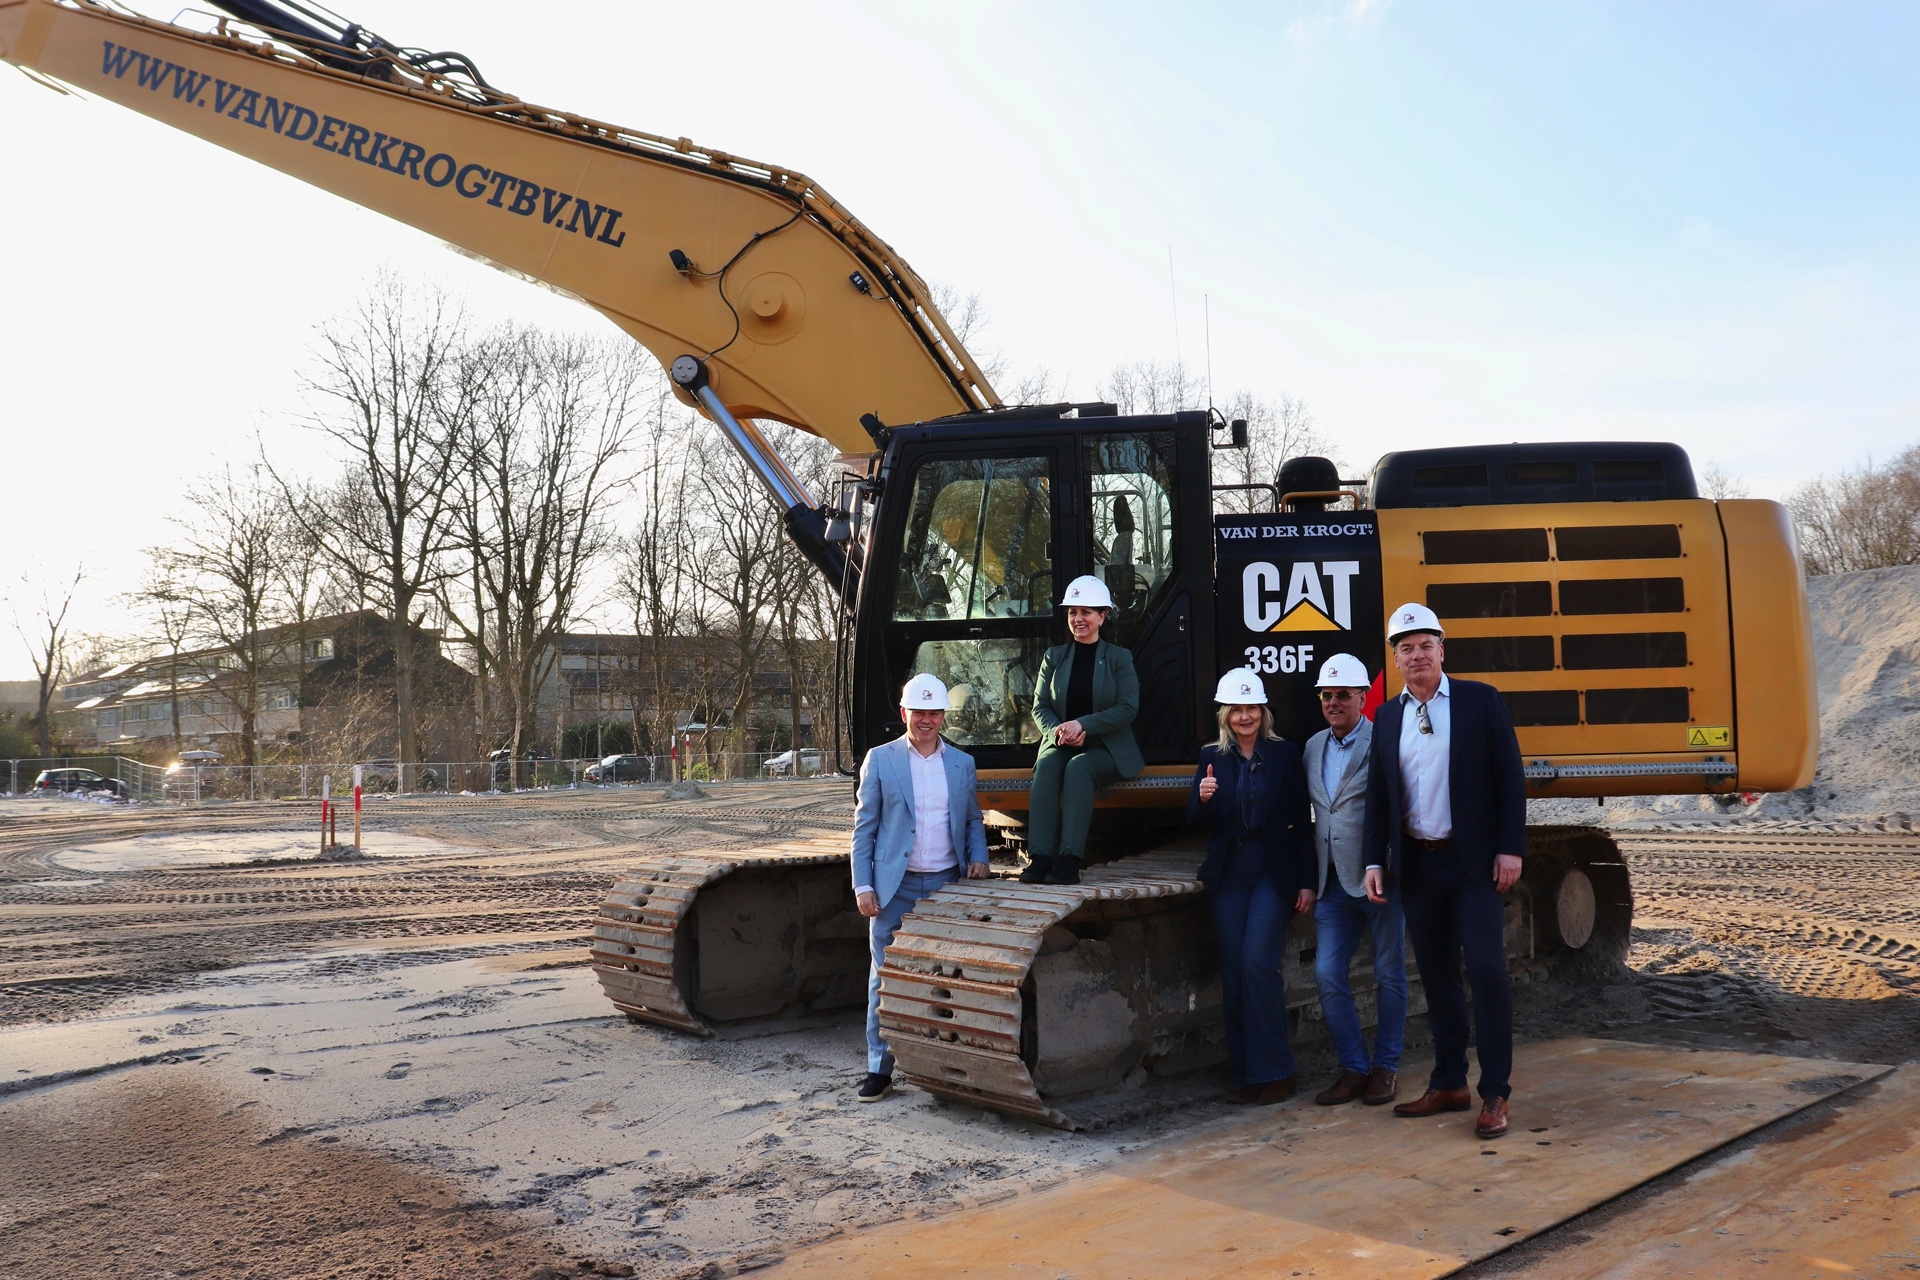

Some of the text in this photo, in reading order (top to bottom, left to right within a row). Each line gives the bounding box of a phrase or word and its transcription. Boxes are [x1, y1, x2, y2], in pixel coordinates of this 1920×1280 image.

[102, 40, 626, 248] WWW.VANDERKROGTBV.NL
[1219, 526, 1258, 539] VAN
[1262, 525, 1299, 538] DER
[1303, 523, 1367, 537] KROGT
[1242, 561, 1360, 632] CAT
[1244, 644, 1314, 674] 336F
